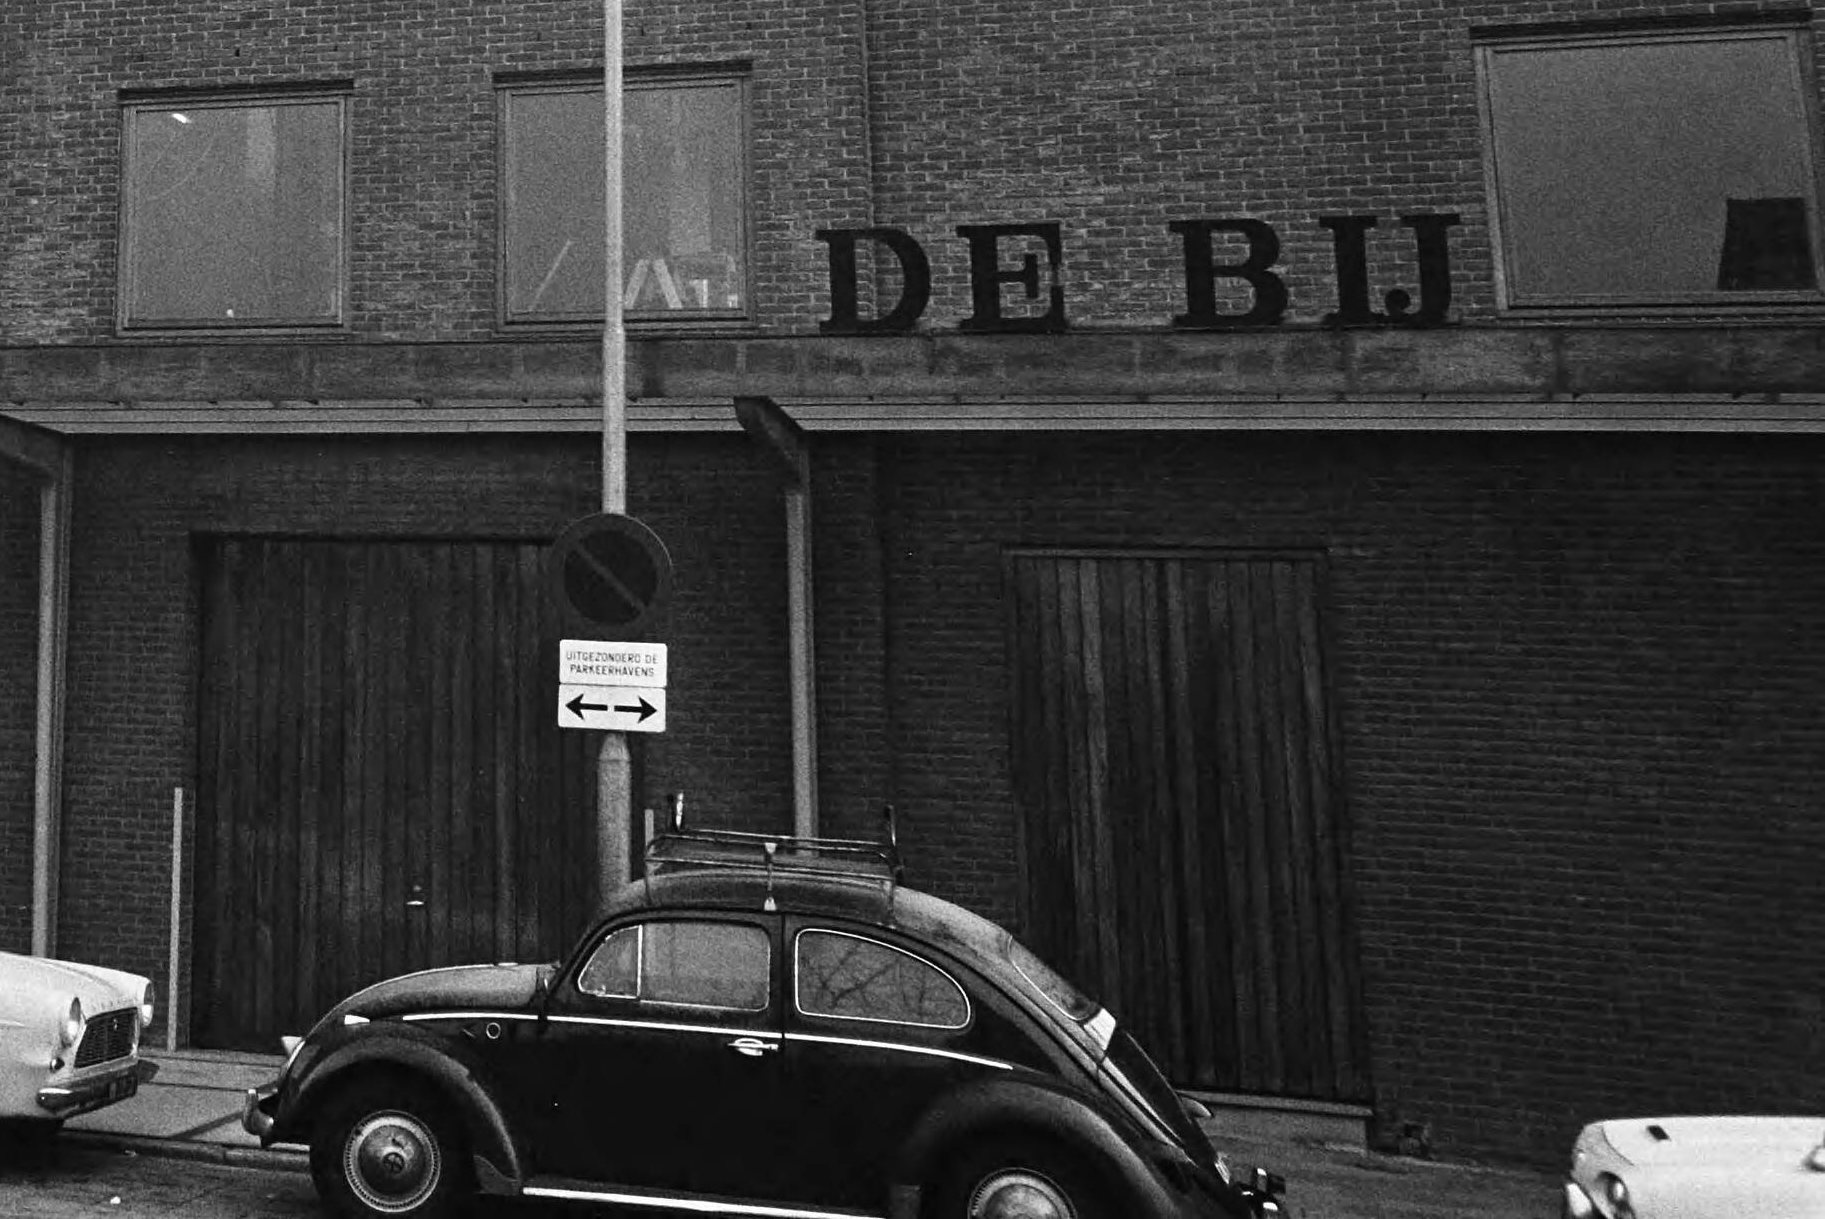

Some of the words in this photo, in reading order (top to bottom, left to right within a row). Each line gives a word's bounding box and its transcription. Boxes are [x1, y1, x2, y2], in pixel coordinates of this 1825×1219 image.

[814, 221, 1068, 333] DE
[1168, 213, 1461, 330] BIJ
[565, 650, 641, 664] UITGEZONDERD
[644, 653, 659, 665] DE
[569, 663, 656, 677] PARKEERHAVENS
